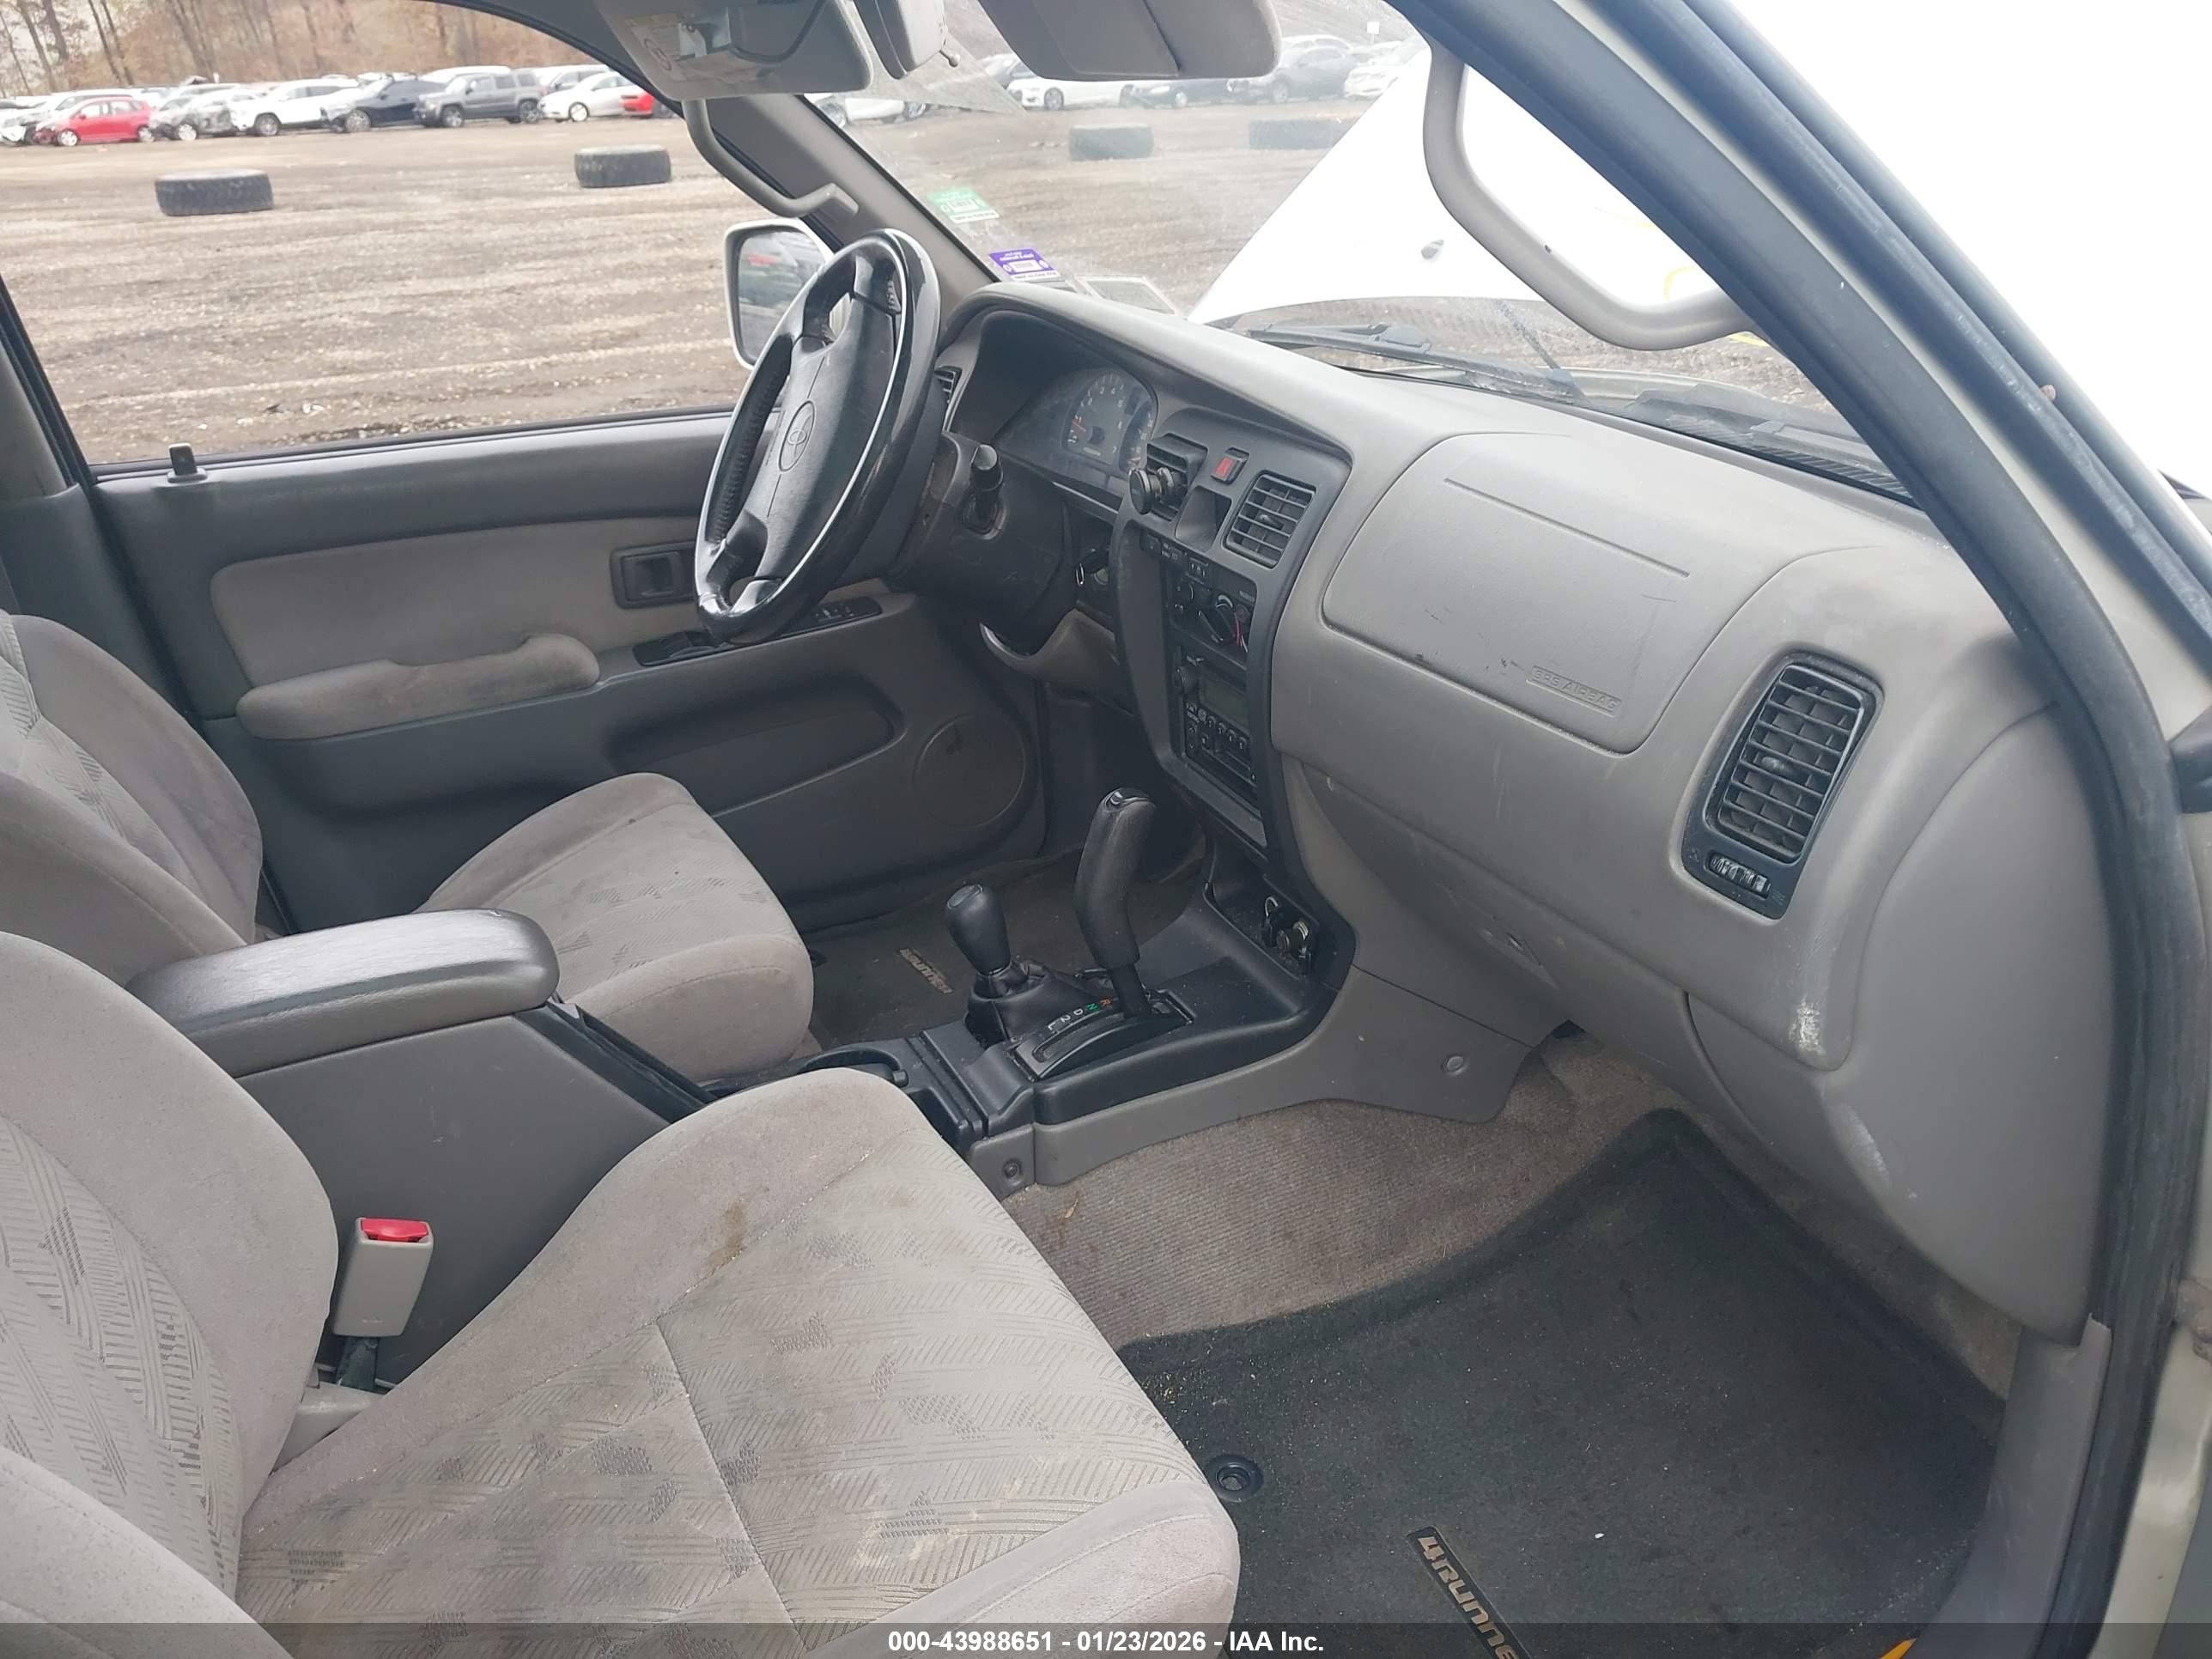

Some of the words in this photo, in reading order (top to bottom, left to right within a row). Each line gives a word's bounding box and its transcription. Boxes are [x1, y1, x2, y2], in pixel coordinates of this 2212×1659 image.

[1086, 1002, 1098, 1011] N
[1100, 998, 1111, 1007] R
[1060, 1014, 1071, 1024] 2
